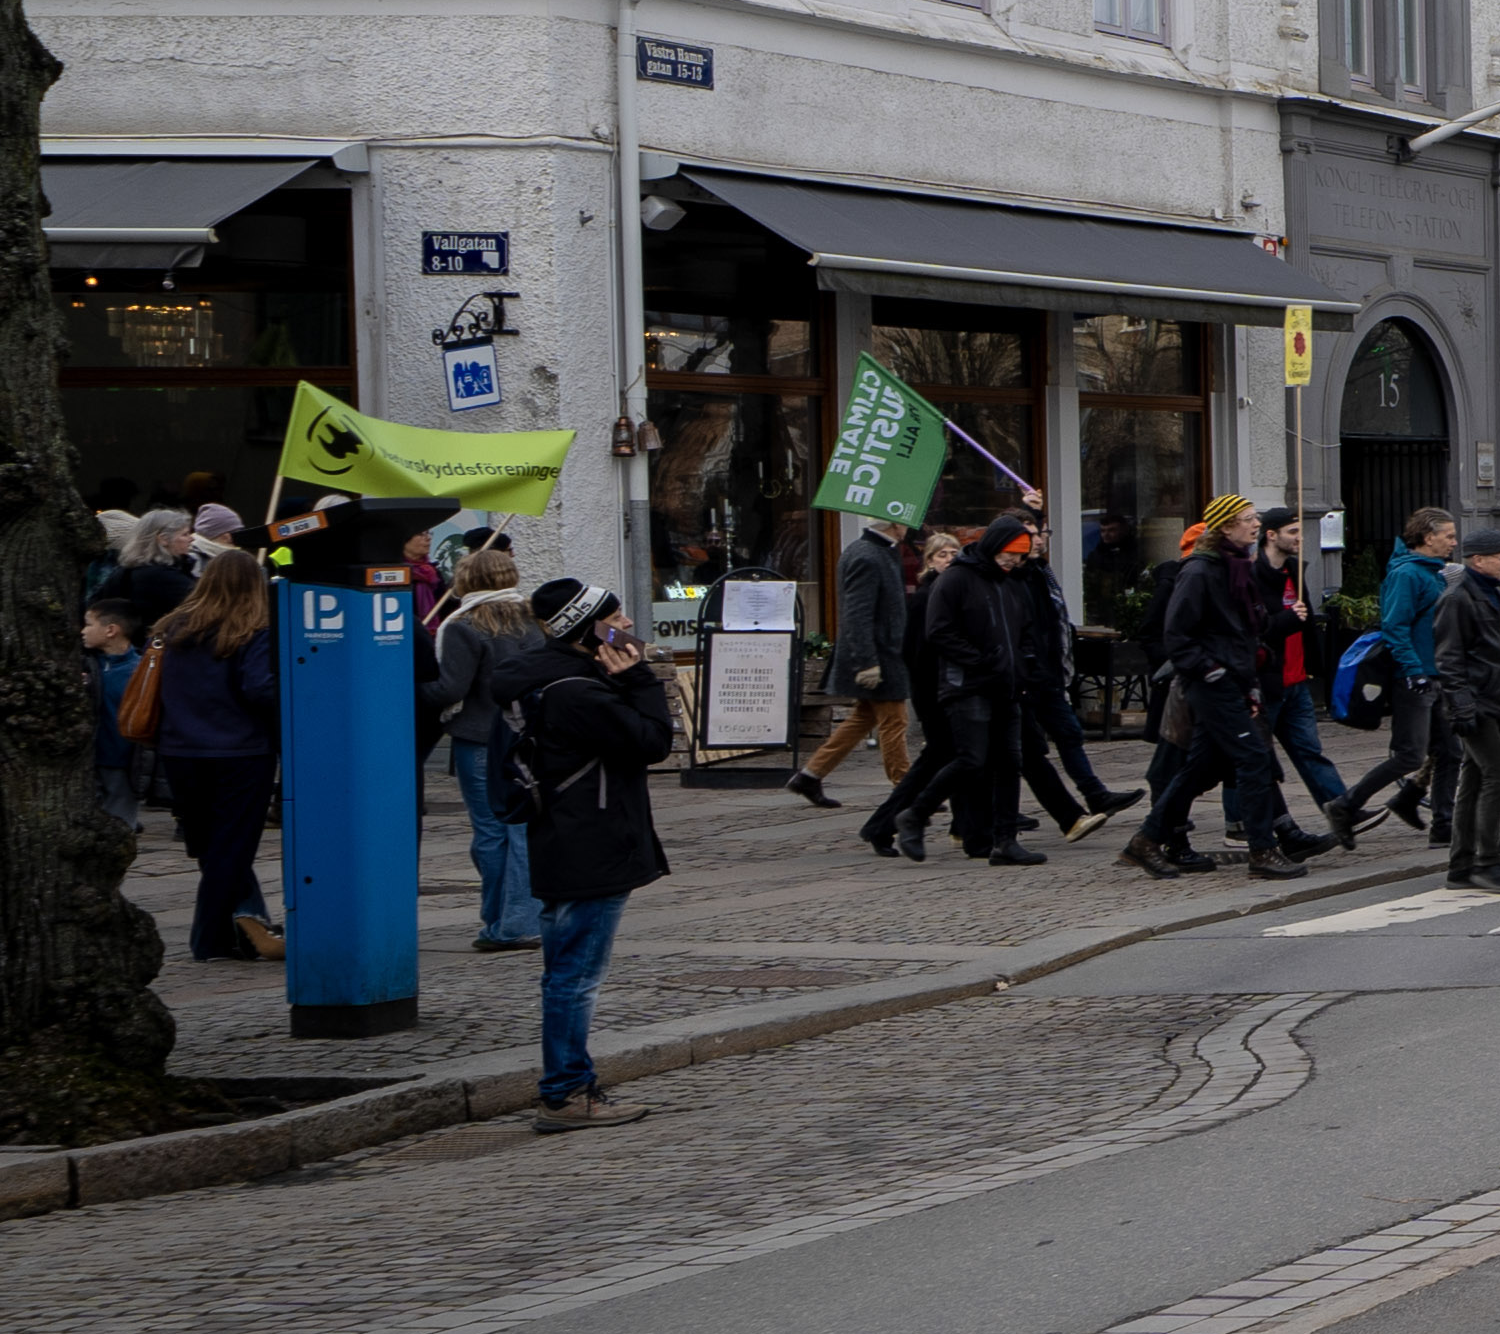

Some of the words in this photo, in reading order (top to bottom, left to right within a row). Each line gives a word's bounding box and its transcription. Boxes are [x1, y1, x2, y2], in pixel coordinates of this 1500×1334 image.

[645, 42, 675, 60] Västra
[677, 48, 708, 65] Hamn-
[647, 61, 672, 76] gatan
[678, 64, 702, 81] 15-13
[432, 235, 496, 254] Vallgatan
[432, 256, 463, 271] 8-10
[1379, 373, 1400, 408] 15
